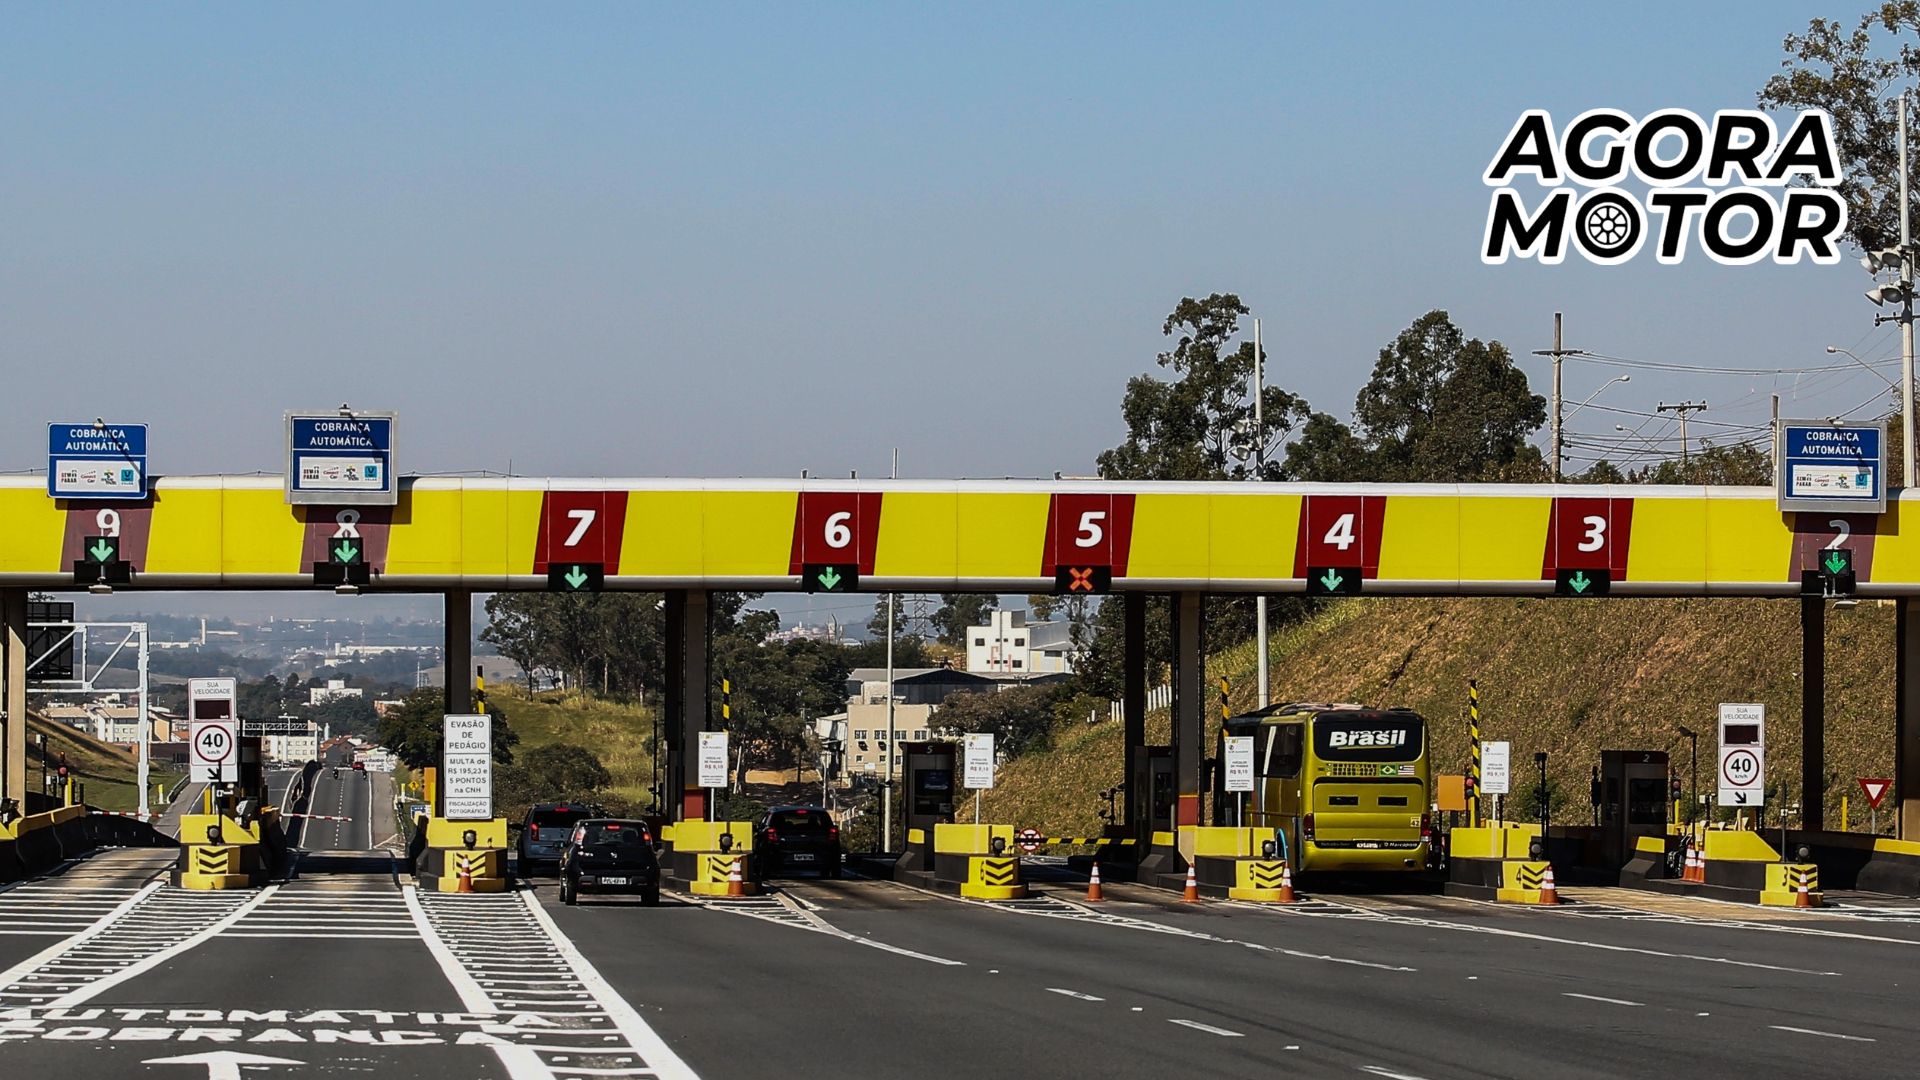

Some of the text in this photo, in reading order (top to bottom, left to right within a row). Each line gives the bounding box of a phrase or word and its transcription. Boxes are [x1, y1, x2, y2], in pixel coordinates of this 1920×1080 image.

[314, 422, 370, 433] COBRANÇA
[66, 439, 130, 451] AUTOMÁTICA
[310, 435, 373, 447] AUTOMÁTICA
[1802, 444, 1863, 455] AUTOMÁTICA
[96, 508, 120, 537] 9
[333, 509, 361, 538] 8
[564, 509, 596, 547] 7
[824, 511, 852, 549] 6
[1075, 511, 1106, 549] 5
[1323, 513, 1356, 551] 4
[1577, 515, 1607, 552] 3
[1824, 519, 1851, 550] 2
[450, 720, 485, 728] EVASÃO
[202, 733, 223, 748] 40
[461, 731, 473, 739] DE
[1329, 730, 1406, 747] Brasil
[449, 740, 486, 749] PEDÁGIO
[926, 745, 934, 754] 5
[1643, 754, 1650, 763] 2
[1731, 758, 1752, 773] 40
